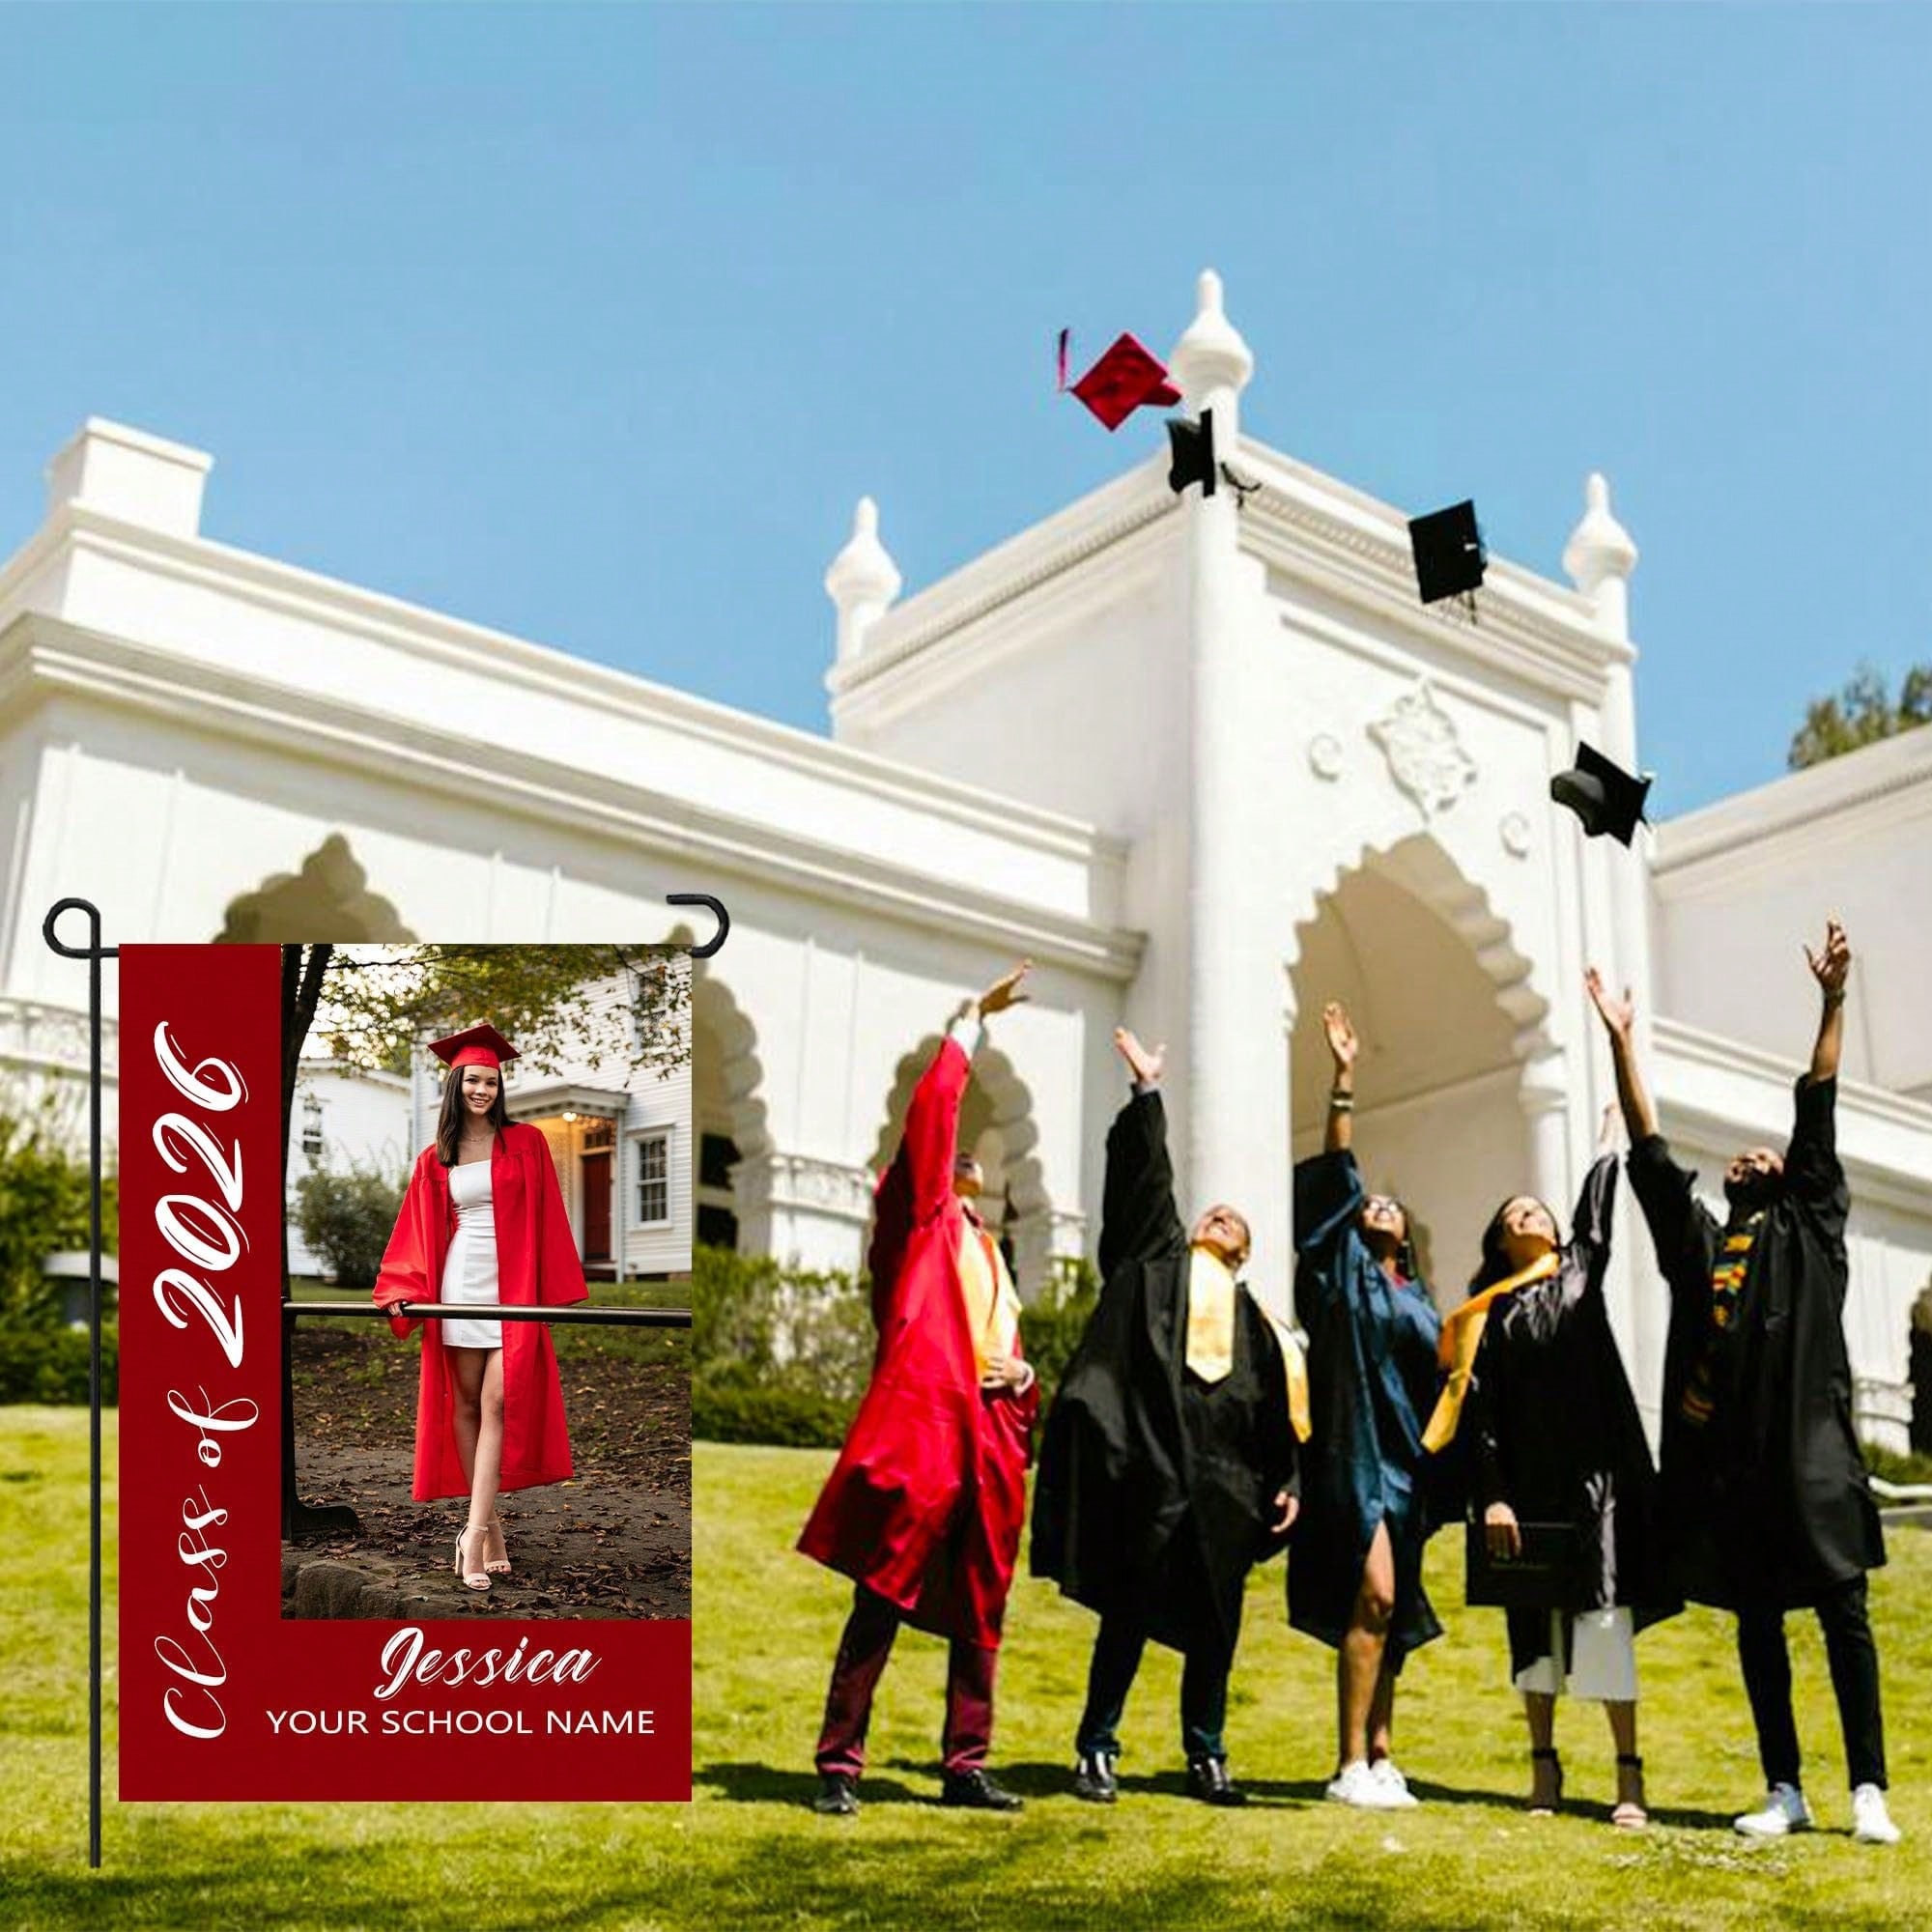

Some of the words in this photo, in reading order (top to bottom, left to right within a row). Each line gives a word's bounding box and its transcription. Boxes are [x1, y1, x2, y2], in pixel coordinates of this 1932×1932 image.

[152, 1021, 250, 1369] 2026
[167, 1385, 259, 1467] of
[155, 1484, 228, 1739] Class
[373, 1627, 602, 1701] Jessica
[267, 1710, 369, 1734] YOUR
[382, 1710, 533, 1734] SCHOOL
[547, 1710, 655, 1734] NAME
